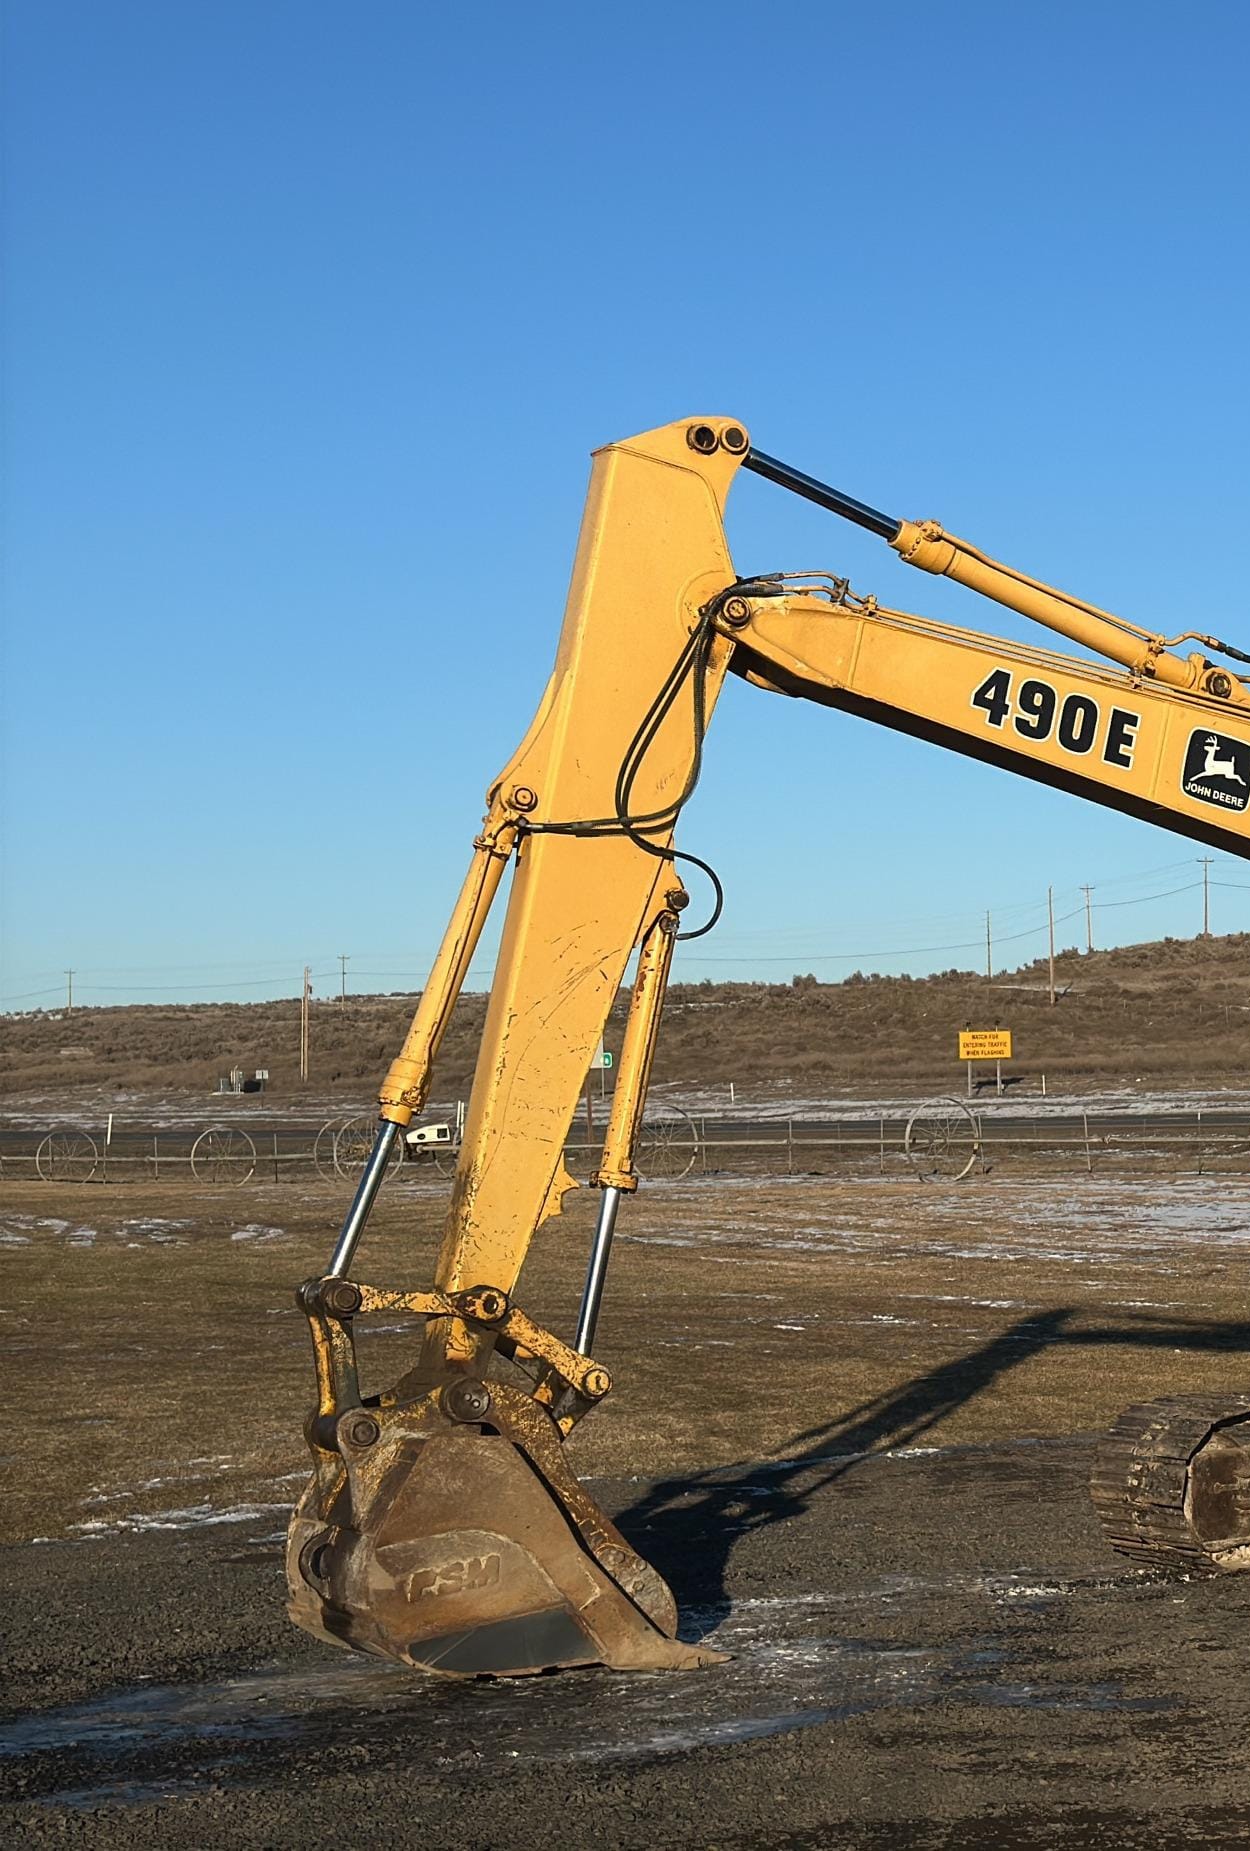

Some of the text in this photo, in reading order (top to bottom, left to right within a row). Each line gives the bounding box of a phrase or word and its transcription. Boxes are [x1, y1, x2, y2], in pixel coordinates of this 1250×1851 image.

[972, 668, 1140, 769] 490E
[1185, 782, 1244, 808] JOHN DEERE
